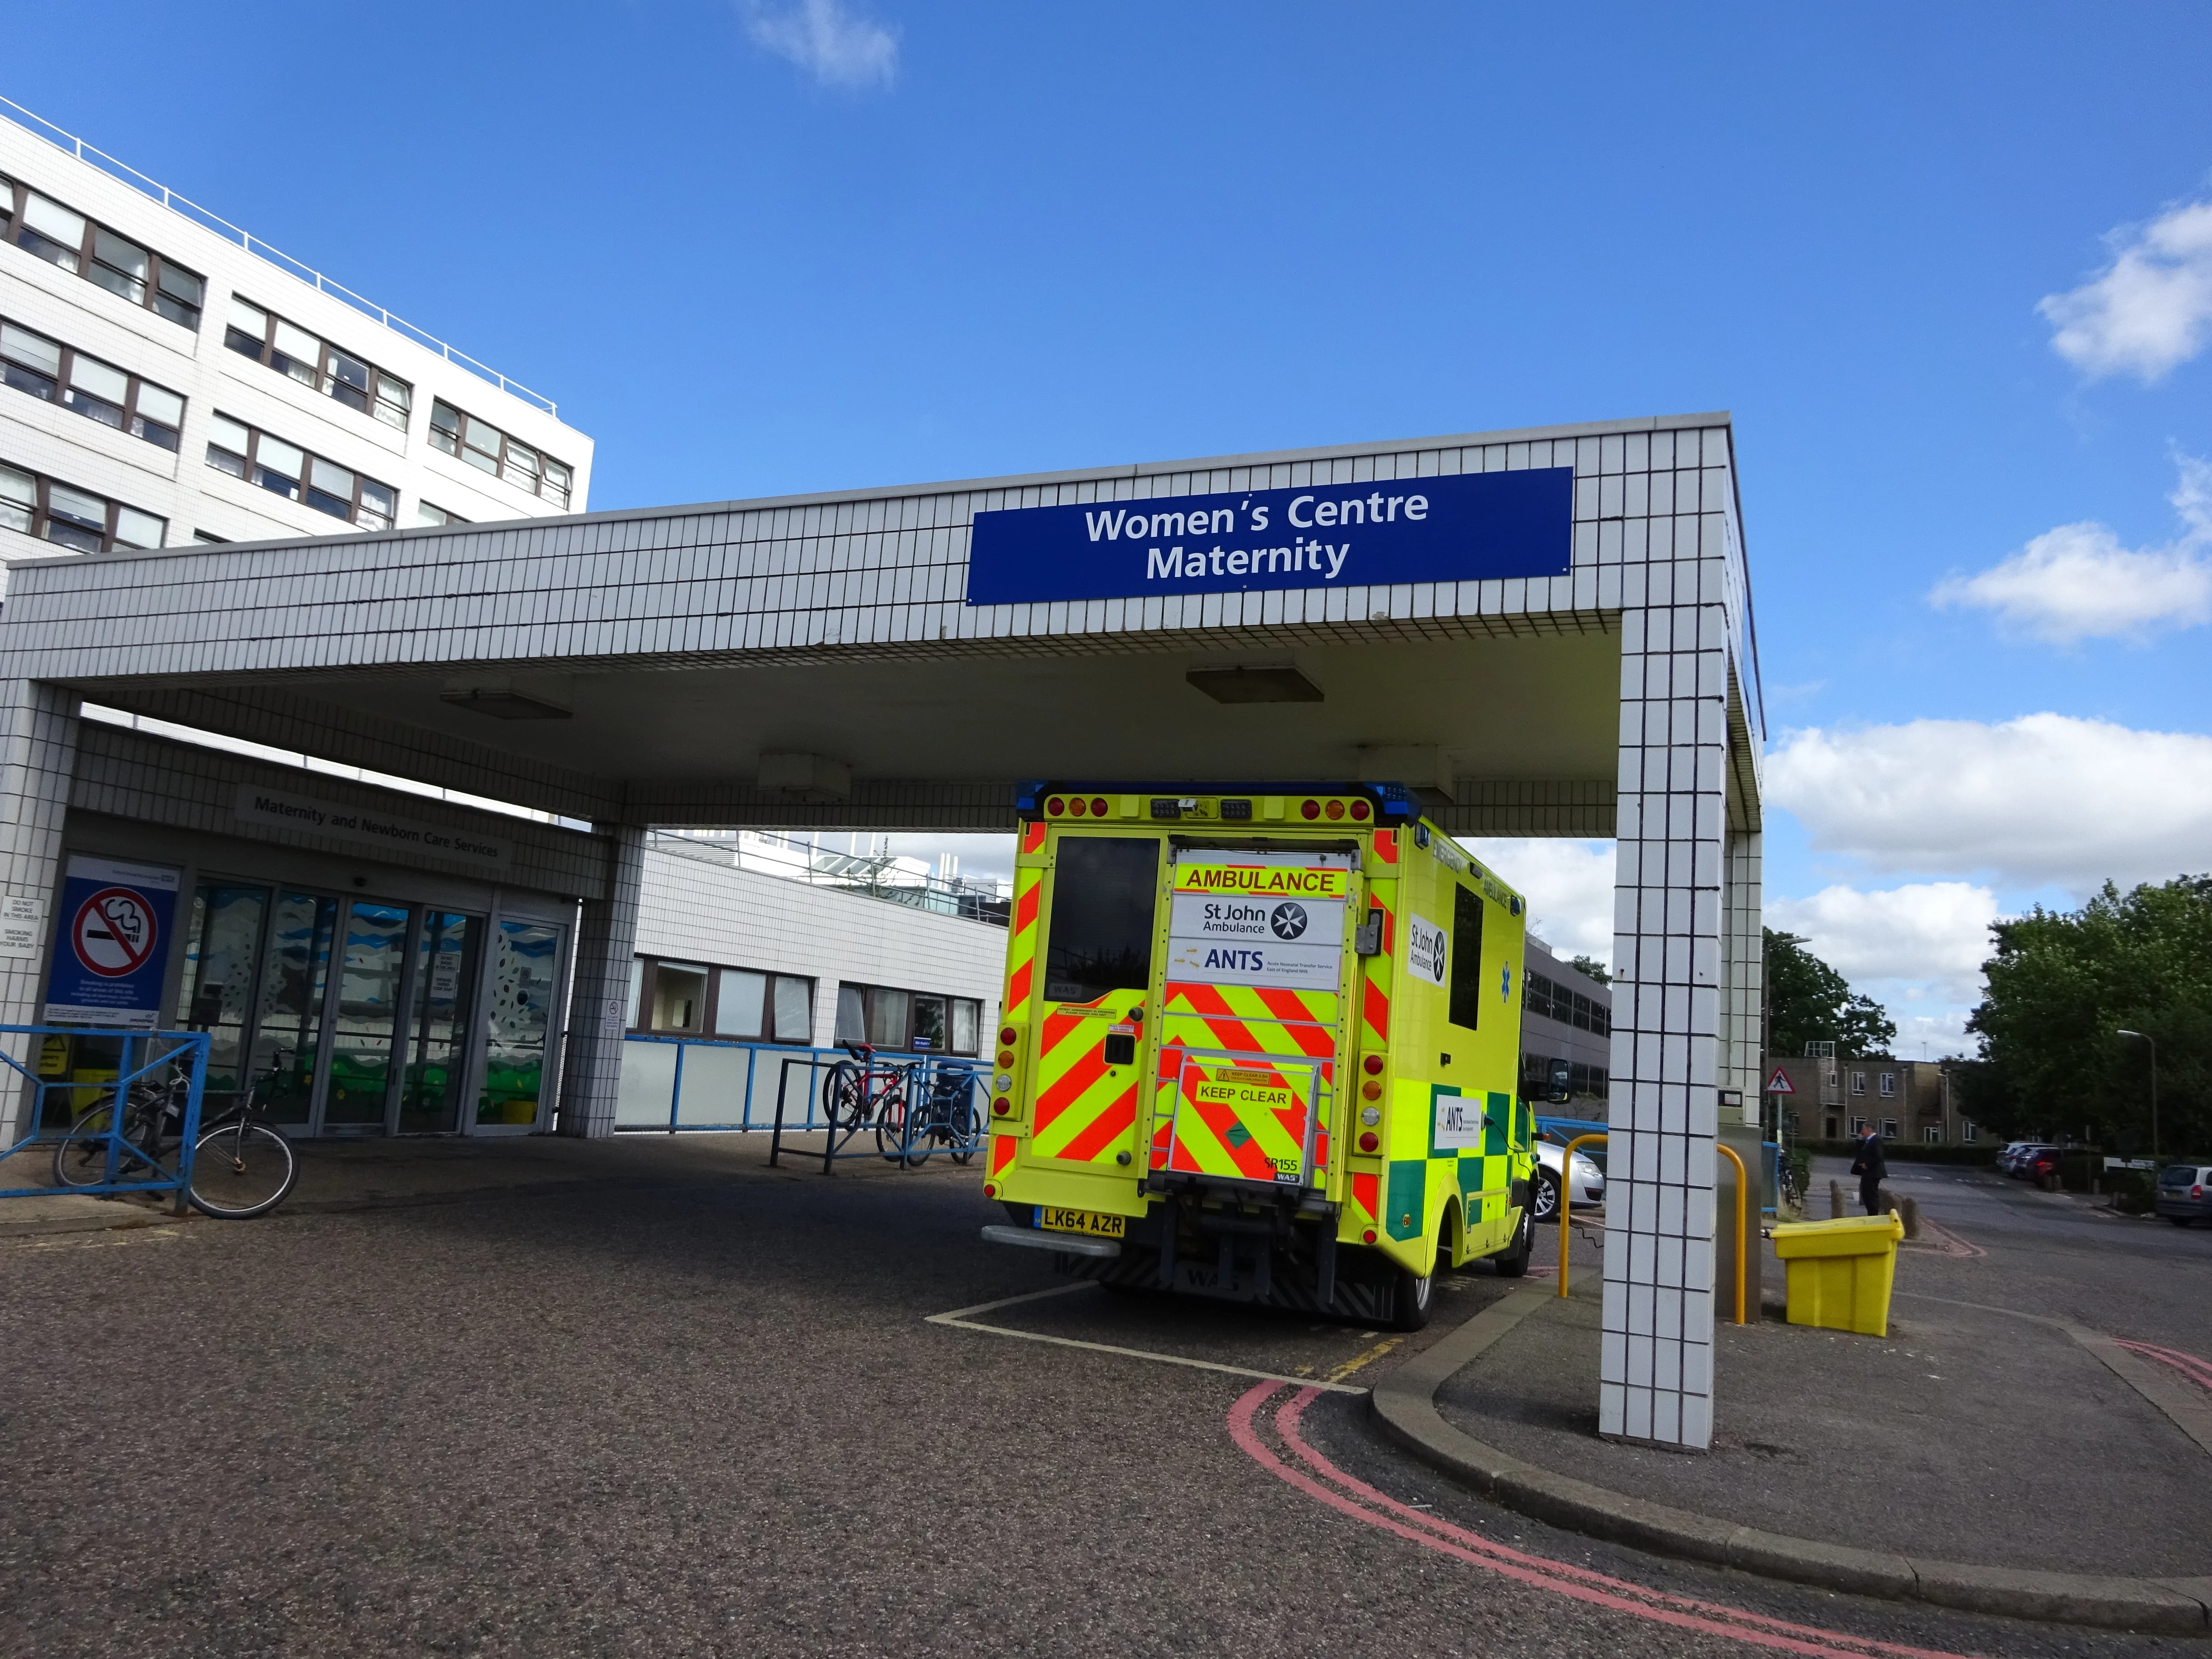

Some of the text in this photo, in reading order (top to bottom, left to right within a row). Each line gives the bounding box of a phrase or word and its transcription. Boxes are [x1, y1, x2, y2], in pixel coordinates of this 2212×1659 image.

[1086, 492, 1428, 541] Women's Centre
[1147, 537, 1350, 579] Maternity
[255, 797, 498, 858] Maternity and Newborn Care Services
[1433, 839, 1462, 875] EMERGENCY
[1186, 869, 1335, 891] AMBULANCE
[1204, 904, 1265, 921] St John
[1203, 921, 1265, 933] Ambulance
[1411, 924, 1433, 955] St John
[1204, 949, 1263, 970] ANTS
[1410, 949, 1431, 971] Ambulance
[1054, 986, 1077, 994] WAS
[1201, 1086, 1286, 1104] KEEP CLEAR
[1446, 1106, 1463, 1131] ANTS
[1265, 1158, 1297, 1171] SR155
[1045, 1209, 1085, 1229] LK64
[1090, 1214, 1122, 1233] AZR
